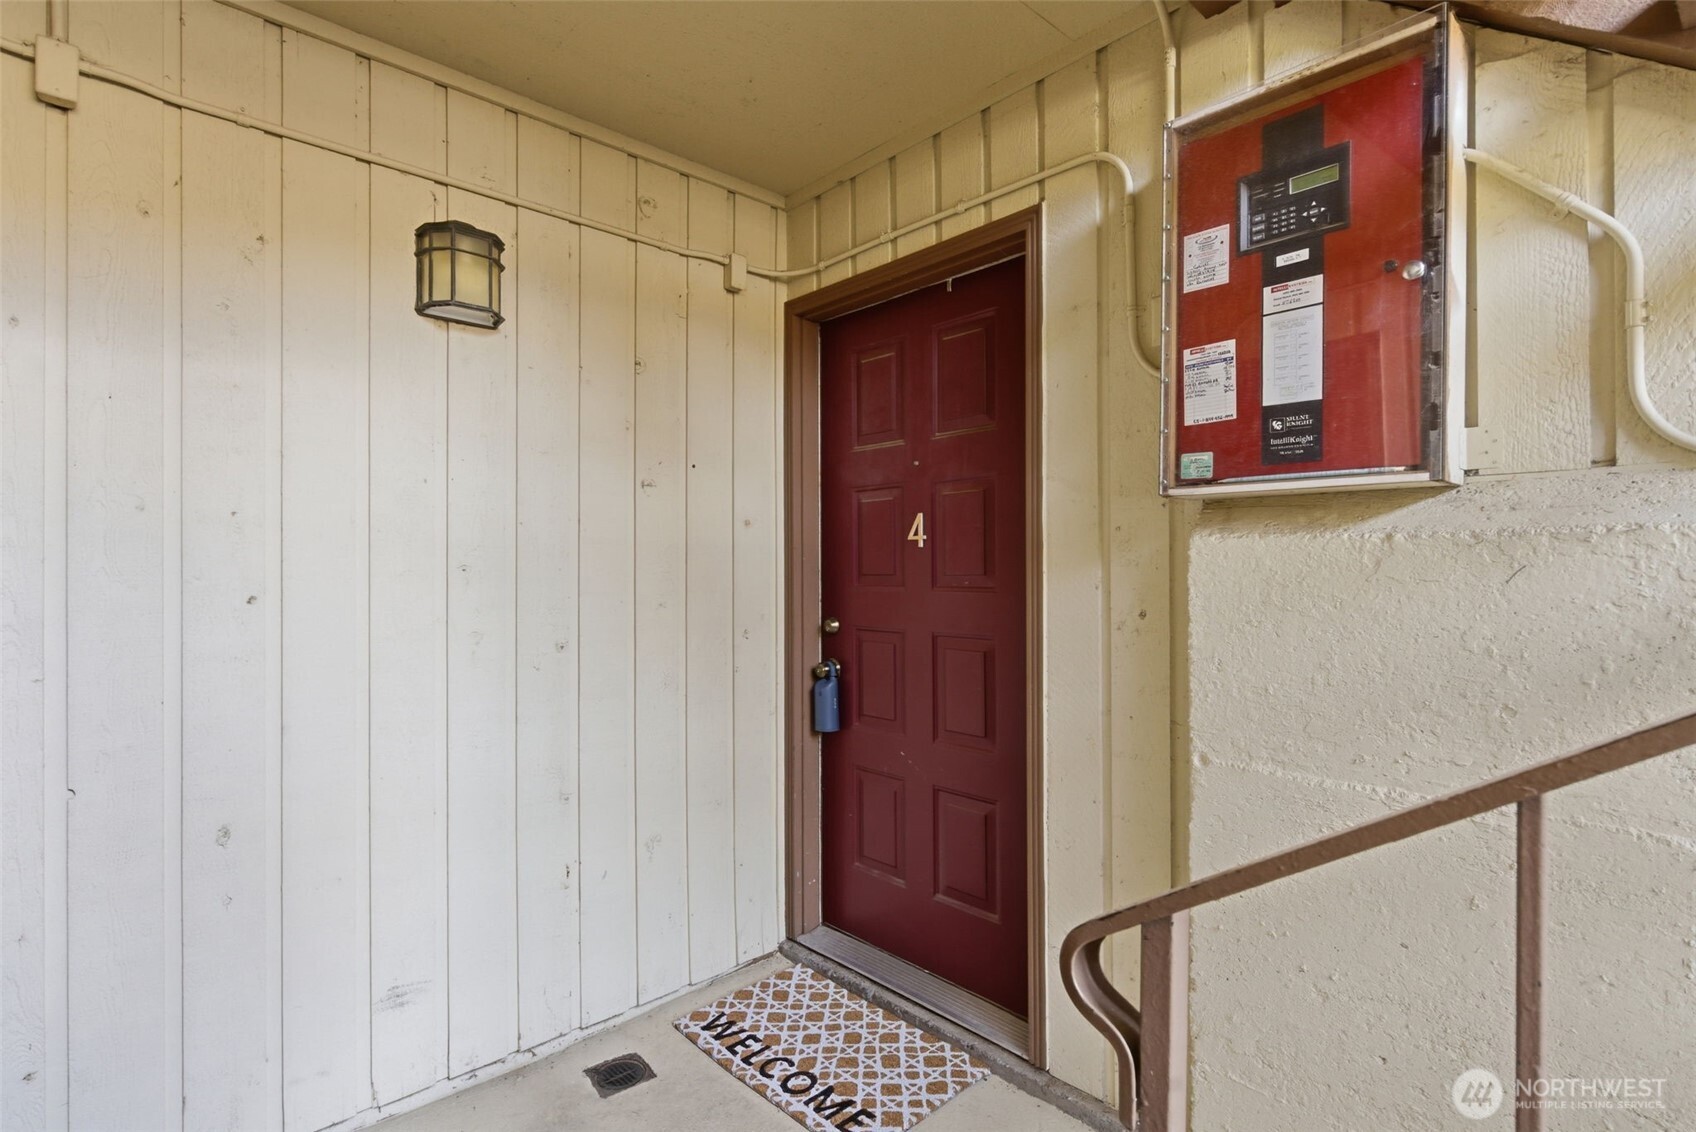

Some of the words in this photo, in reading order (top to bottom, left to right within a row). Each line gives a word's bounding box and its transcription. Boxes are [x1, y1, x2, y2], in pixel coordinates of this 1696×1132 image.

[1270, 435, 1313, 445] IntelliKnight
[907, 512, 927, 548] 4
[701, 1012, 877, 1132] WELCOME
